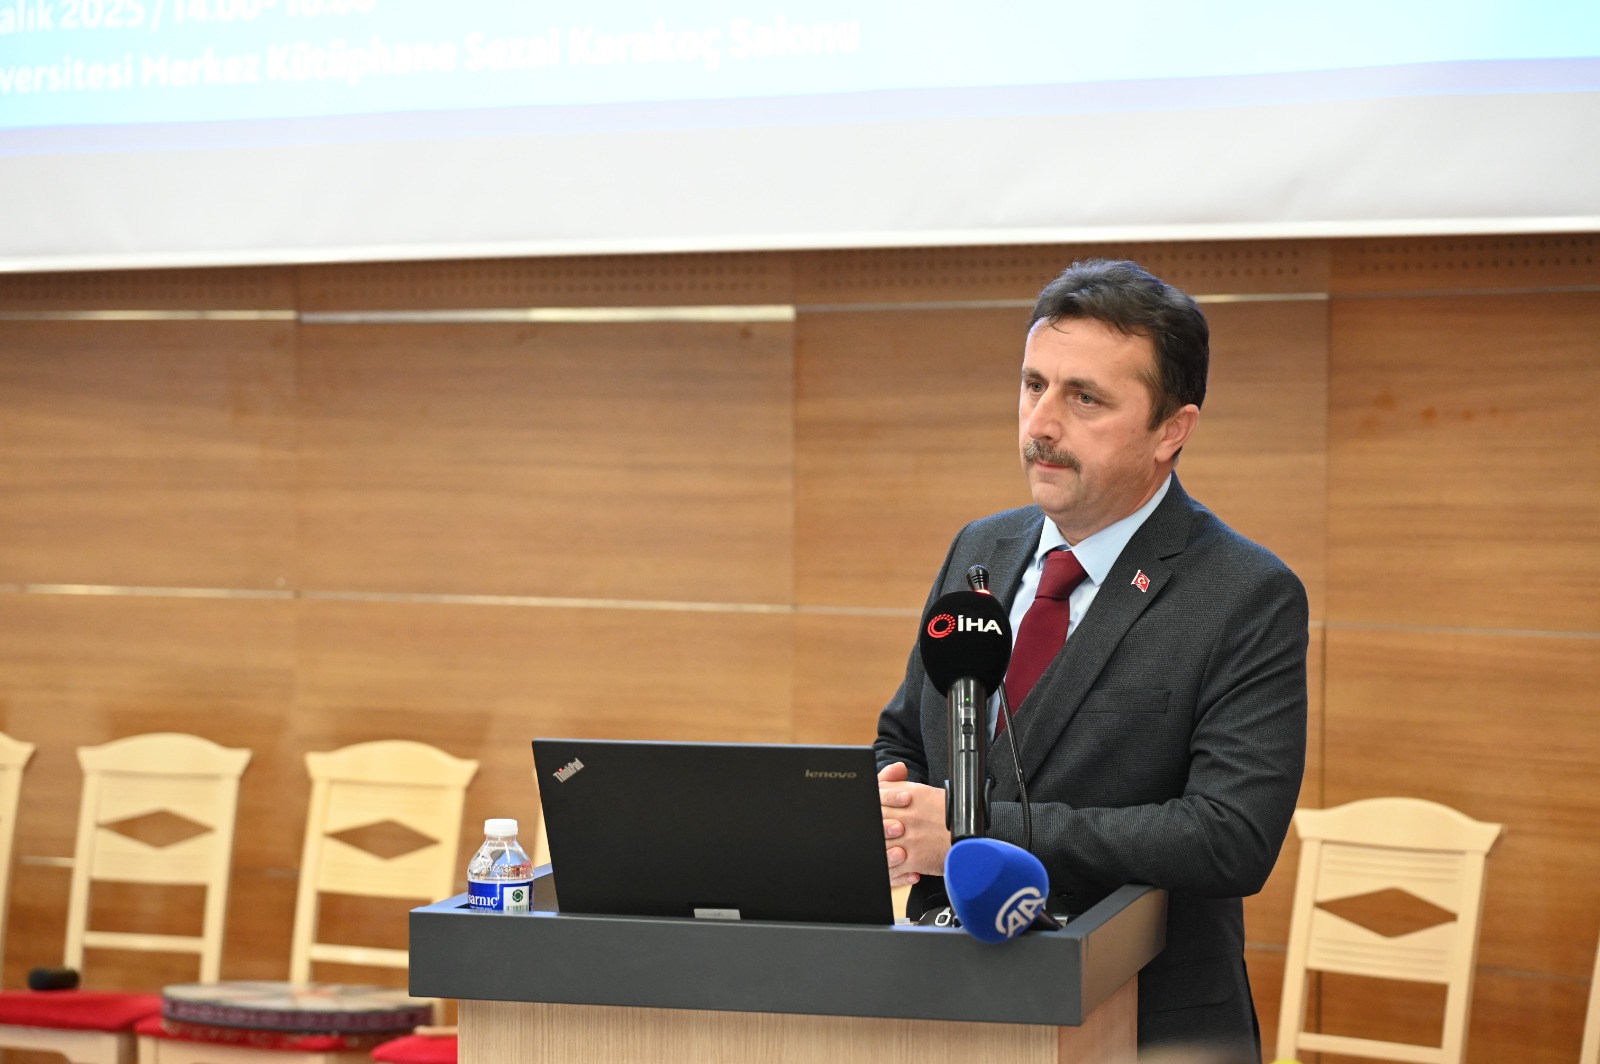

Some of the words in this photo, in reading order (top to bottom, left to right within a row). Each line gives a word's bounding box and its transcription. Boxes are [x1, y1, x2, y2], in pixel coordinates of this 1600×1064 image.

[59, 0, 146, 29] 2025
[0, 52, 134, 94] versitesi
[140, 47, 260, 87] Merkez
[266, 35, 457, 87] Kütüphane
[569, 17, 721, 72] Karakoç
[729, 12, 860, 59] Salonu
[805, 769, 857, 779] lenovo
